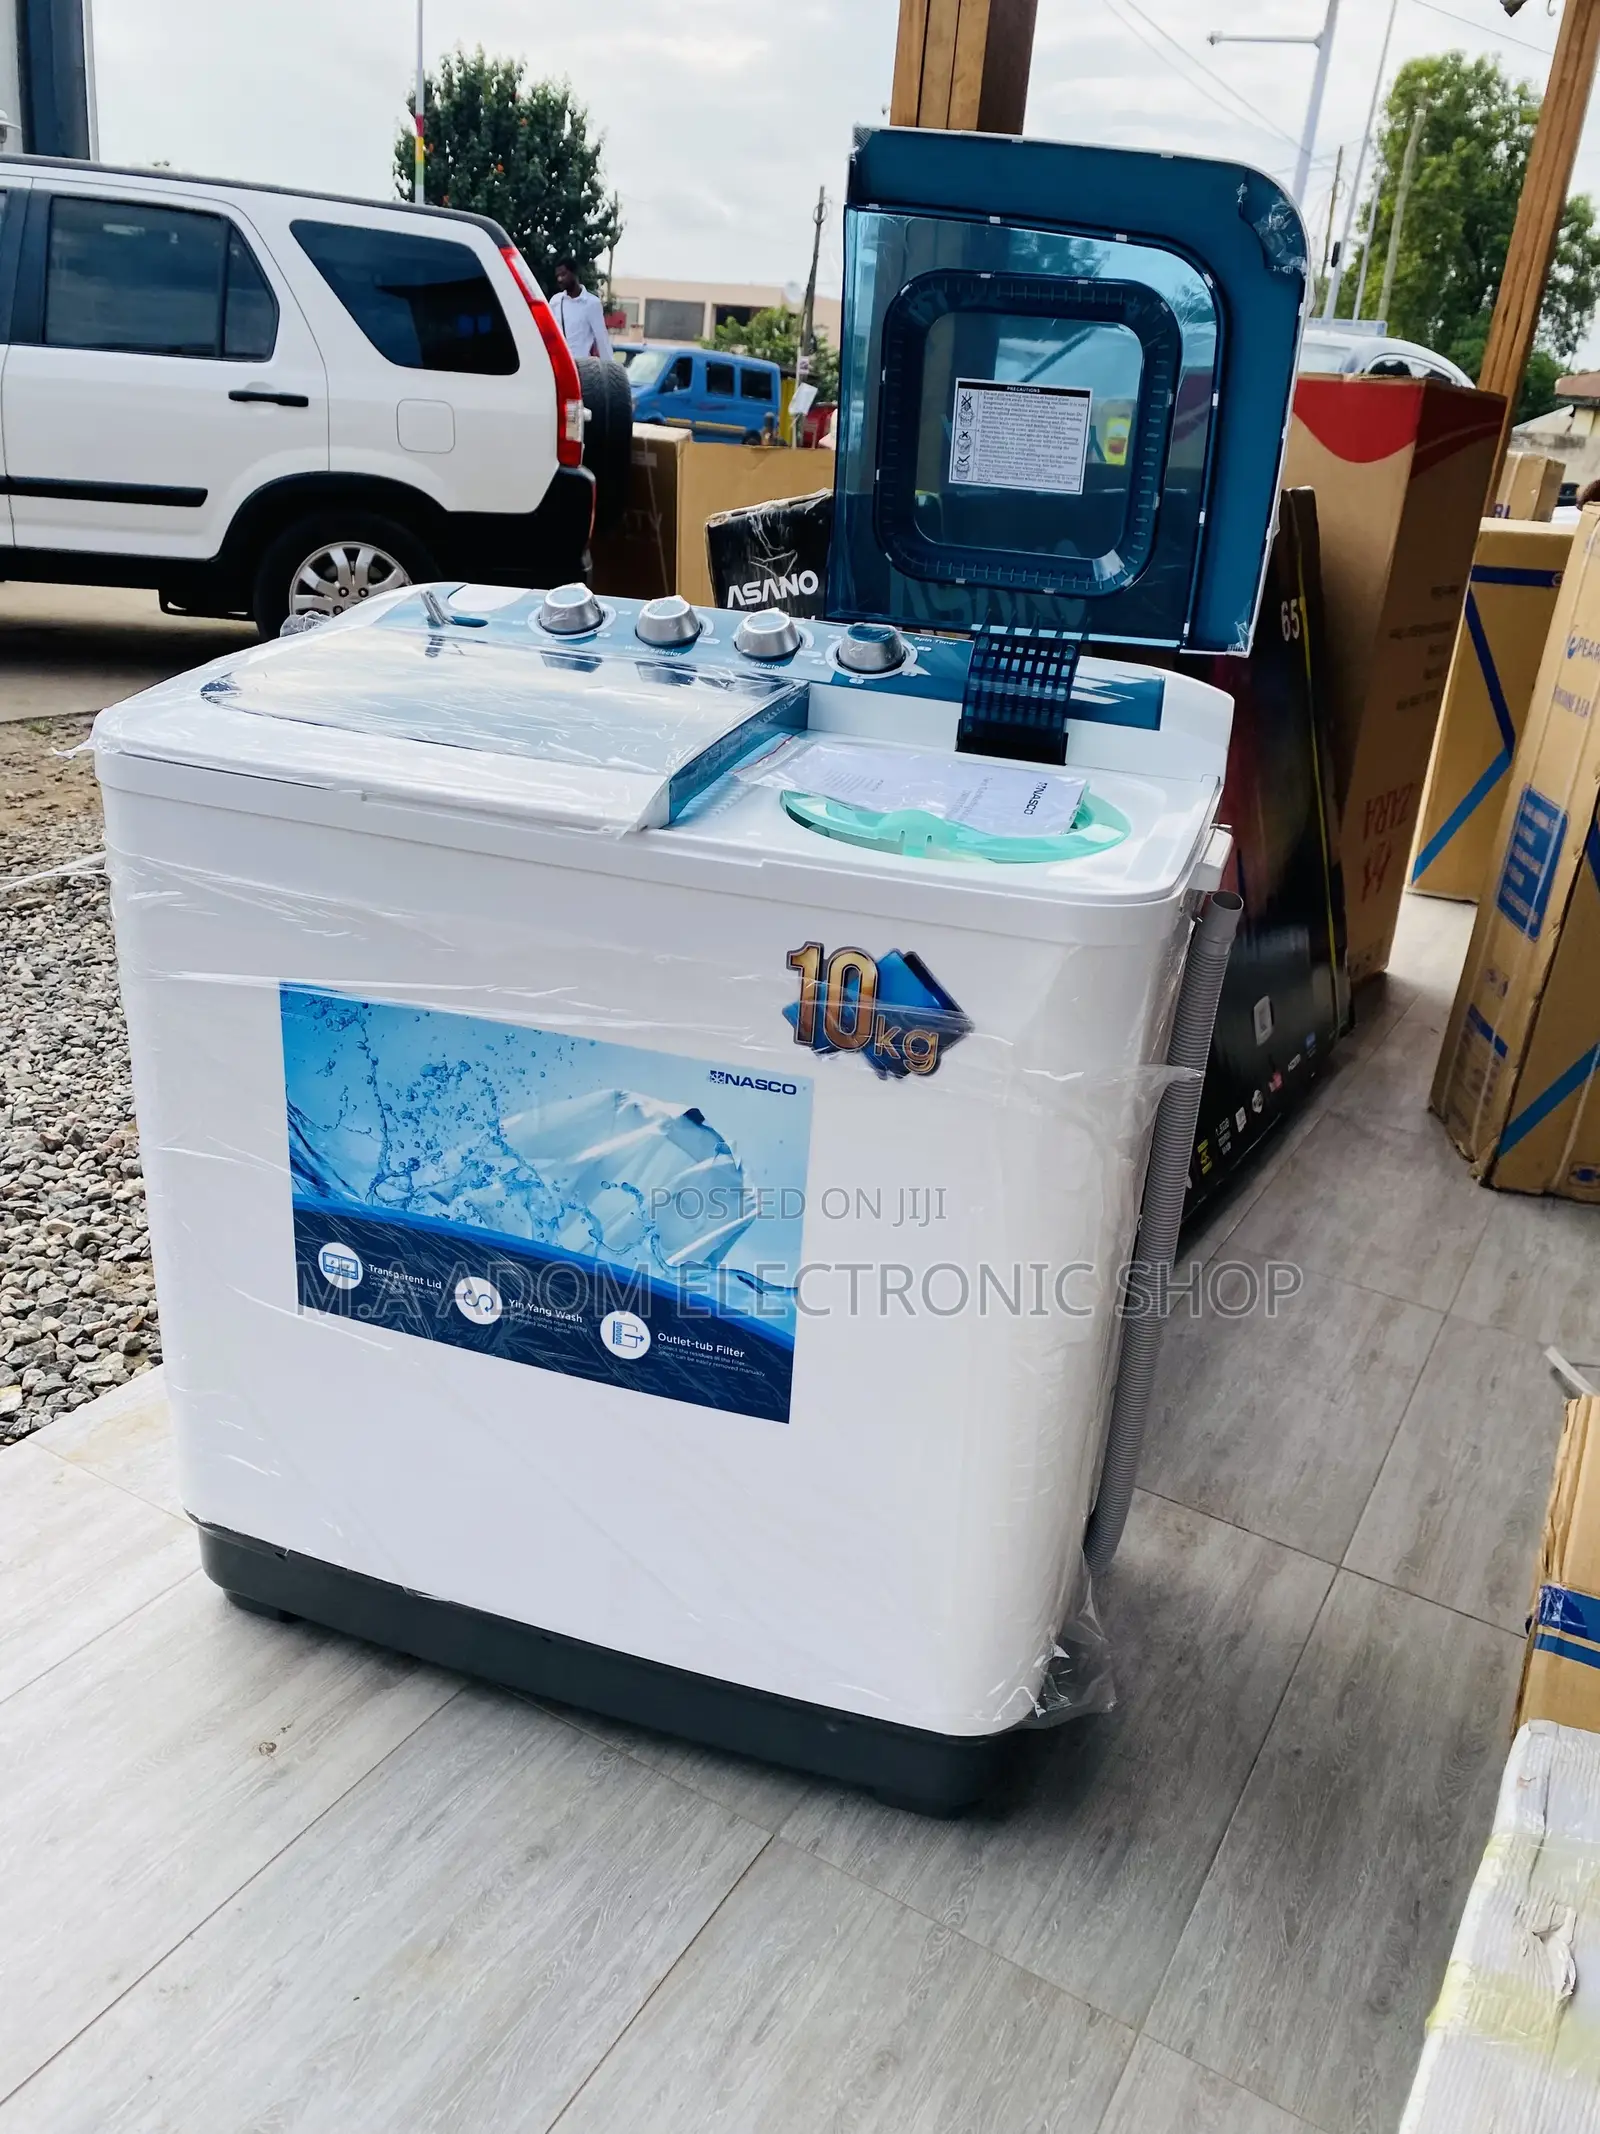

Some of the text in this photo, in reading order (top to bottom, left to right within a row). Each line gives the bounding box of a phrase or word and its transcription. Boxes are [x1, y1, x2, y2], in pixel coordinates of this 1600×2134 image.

[1006, 385, 1041, 394] PRECAUTIONS
[727, 570, 819, 608] ASANO
[1023, 787, 1045, 816] NASCO
[725, 1073, 798, 1096] NASCO
[368, 1263, 424, 1286] Transparent
[426, 1278, 442, 1290] Lid
[508, 1298, 525, 1310] Yin
[527, 1302, 552, 1318] Yang
[555, 1309, 583, 1324] Wash
[657, 1331, 746, 1359] Outlet-tub Filter
